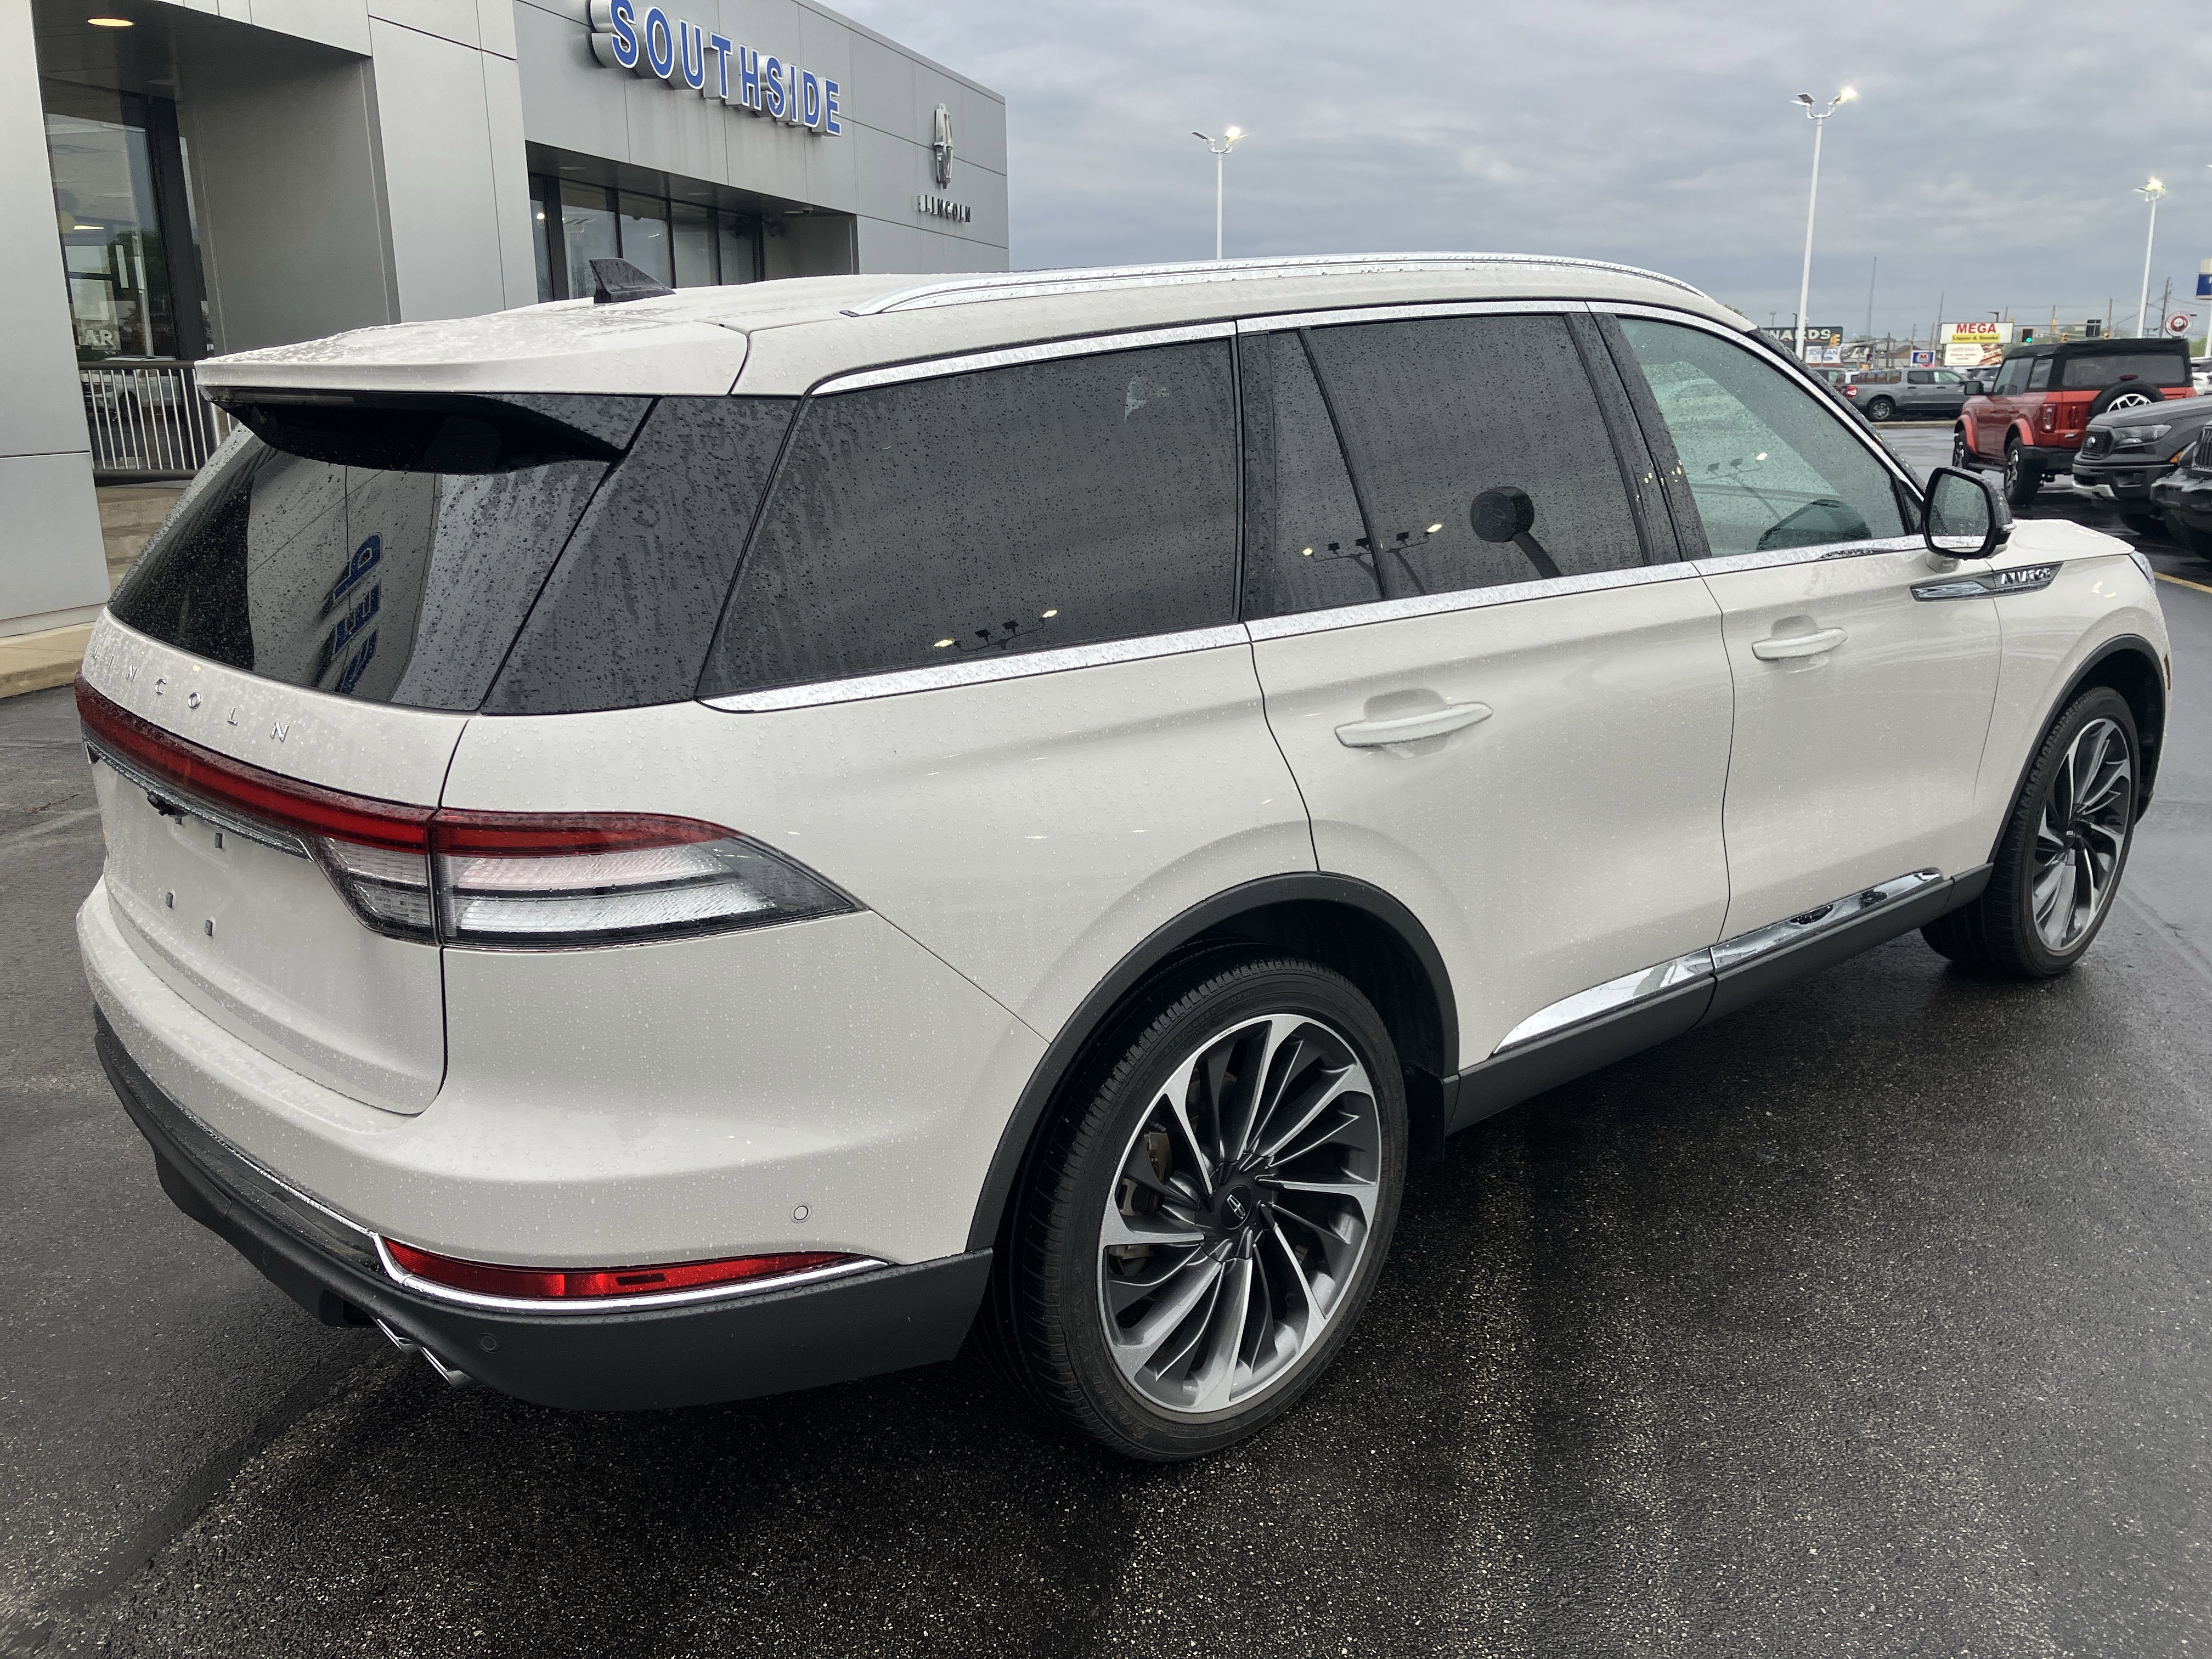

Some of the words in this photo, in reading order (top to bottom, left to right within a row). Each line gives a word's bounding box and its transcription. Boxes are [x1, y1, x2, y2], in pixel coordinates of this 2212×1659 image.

[610, 0, 842, 137] SOUTHSIDE
[923, 194, 971, 222] LINCOLN
[1956, 322, 1997, 334] MEGA
[93, 644, 290, 742] LINCOLN
